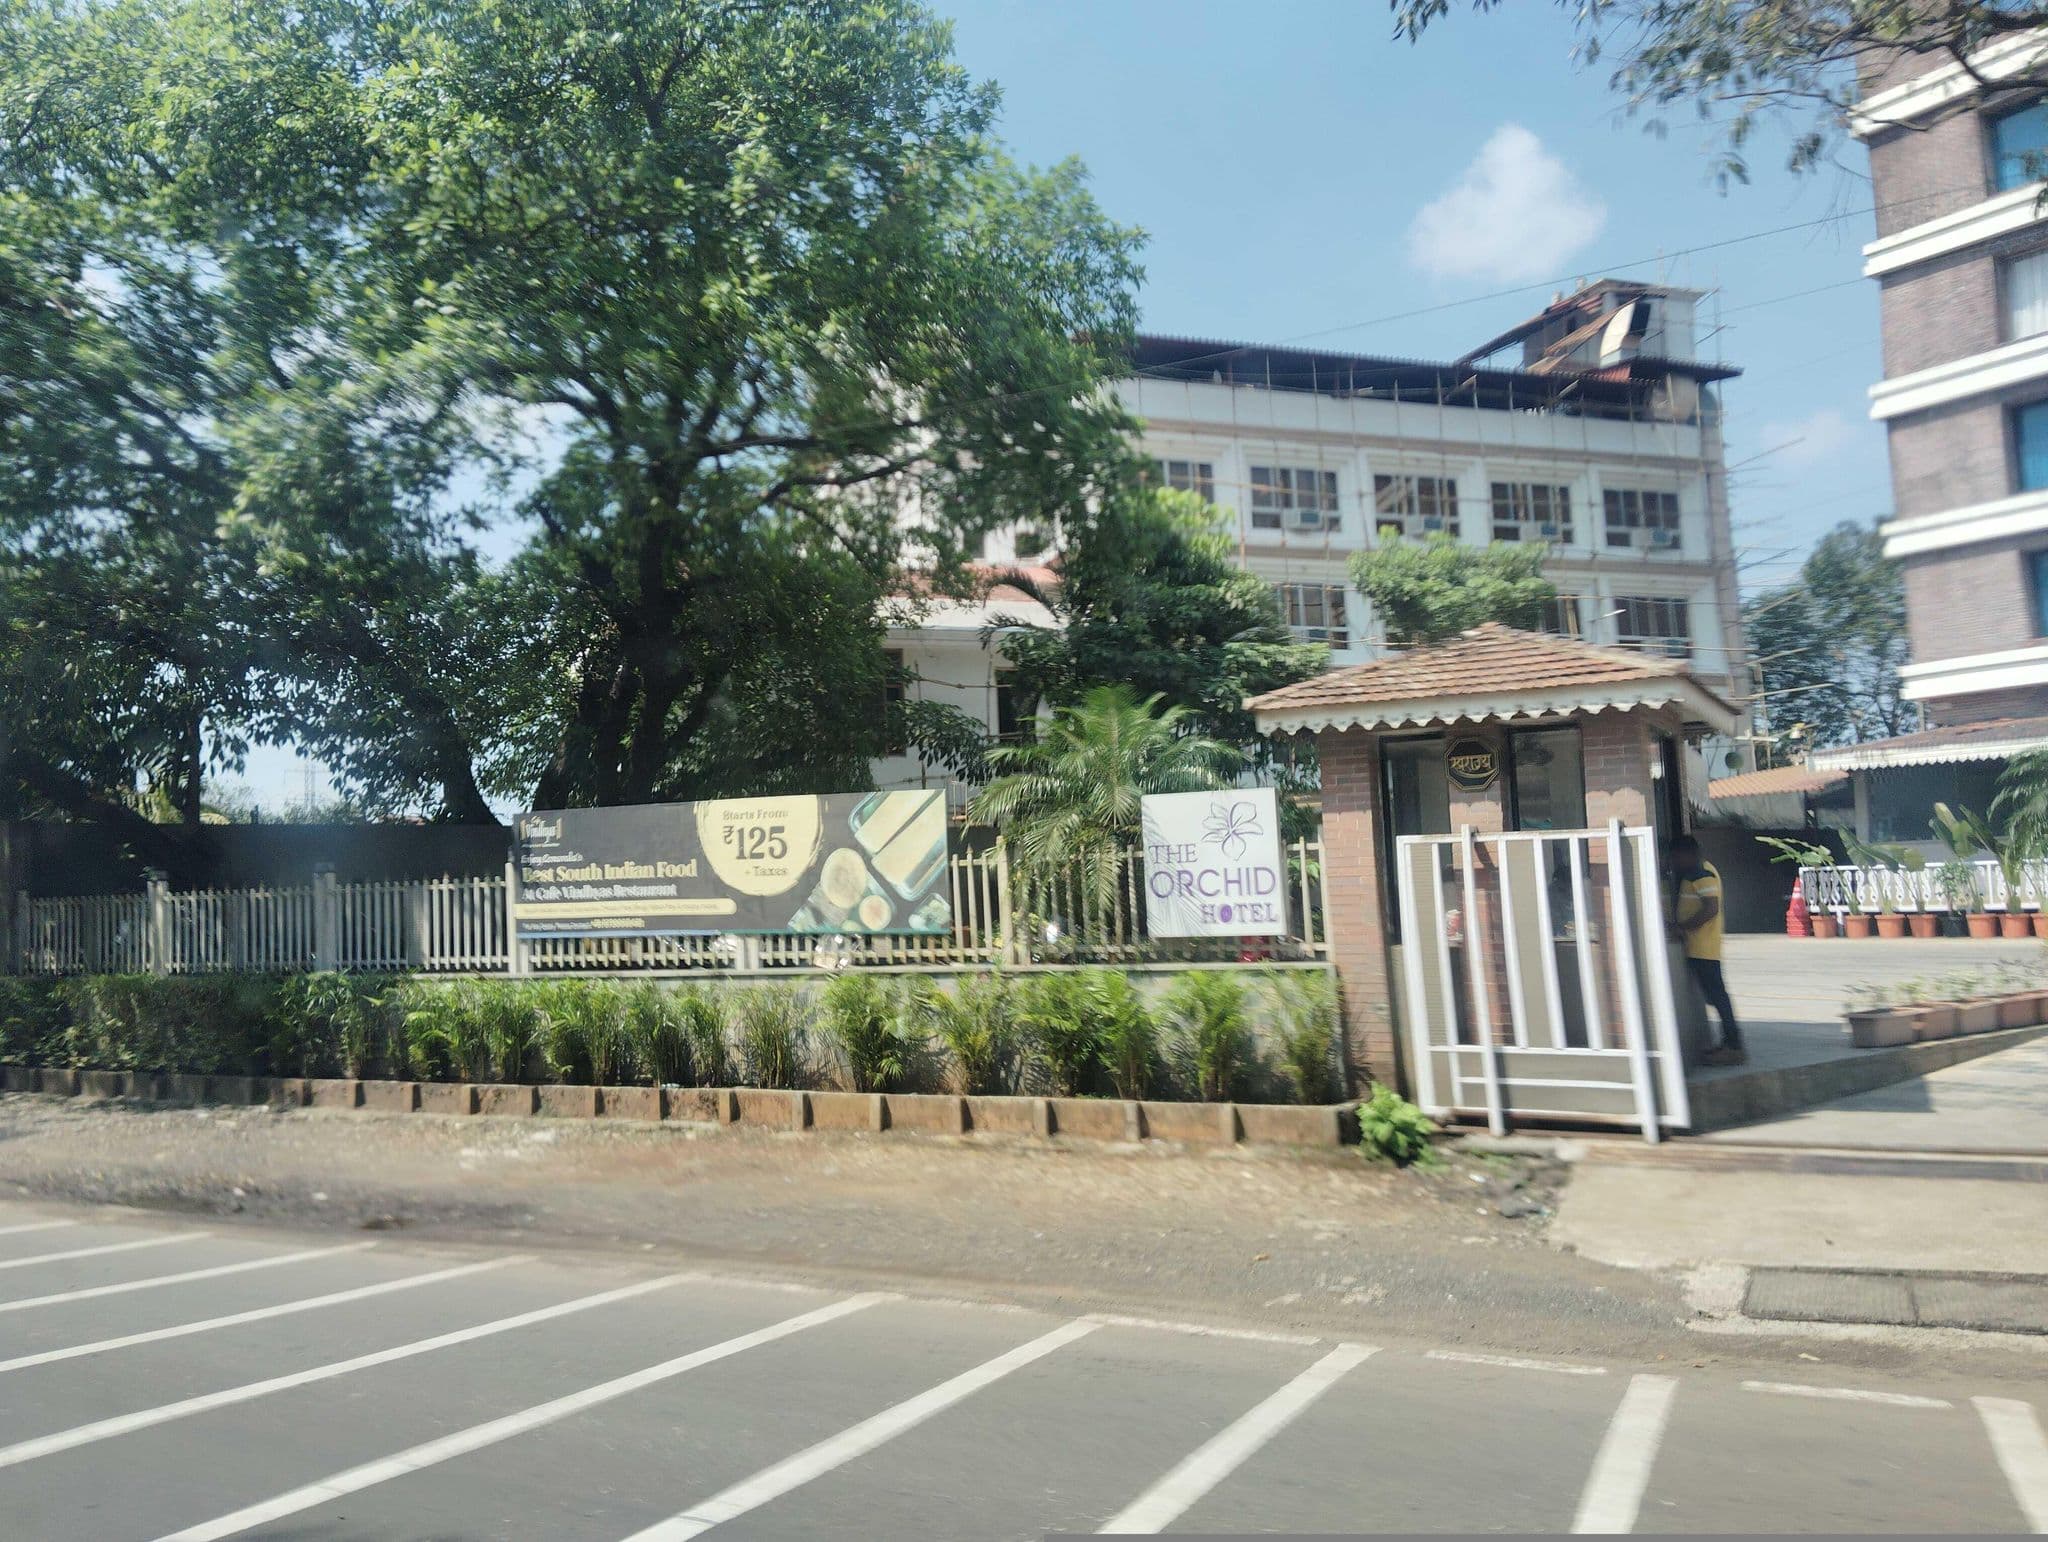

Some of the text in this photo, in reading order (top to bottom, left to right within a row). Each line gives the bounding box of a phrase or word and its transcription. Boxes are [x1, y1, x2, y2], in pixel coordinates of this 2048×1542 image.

[722, 809, 755, 822] Starts
[723, 825, 788, 860] ₹125
[1149, 843, 1199, 865] THE
[522, 858, 697, 882] Best South Indian Food
[753, 865, 787, 877] Taxes
[613, 883, 677, 898] Restaurant
[1150, 867, 1276, 899] ORCHID
[1201, 903, 1279, 924] HOTEL
